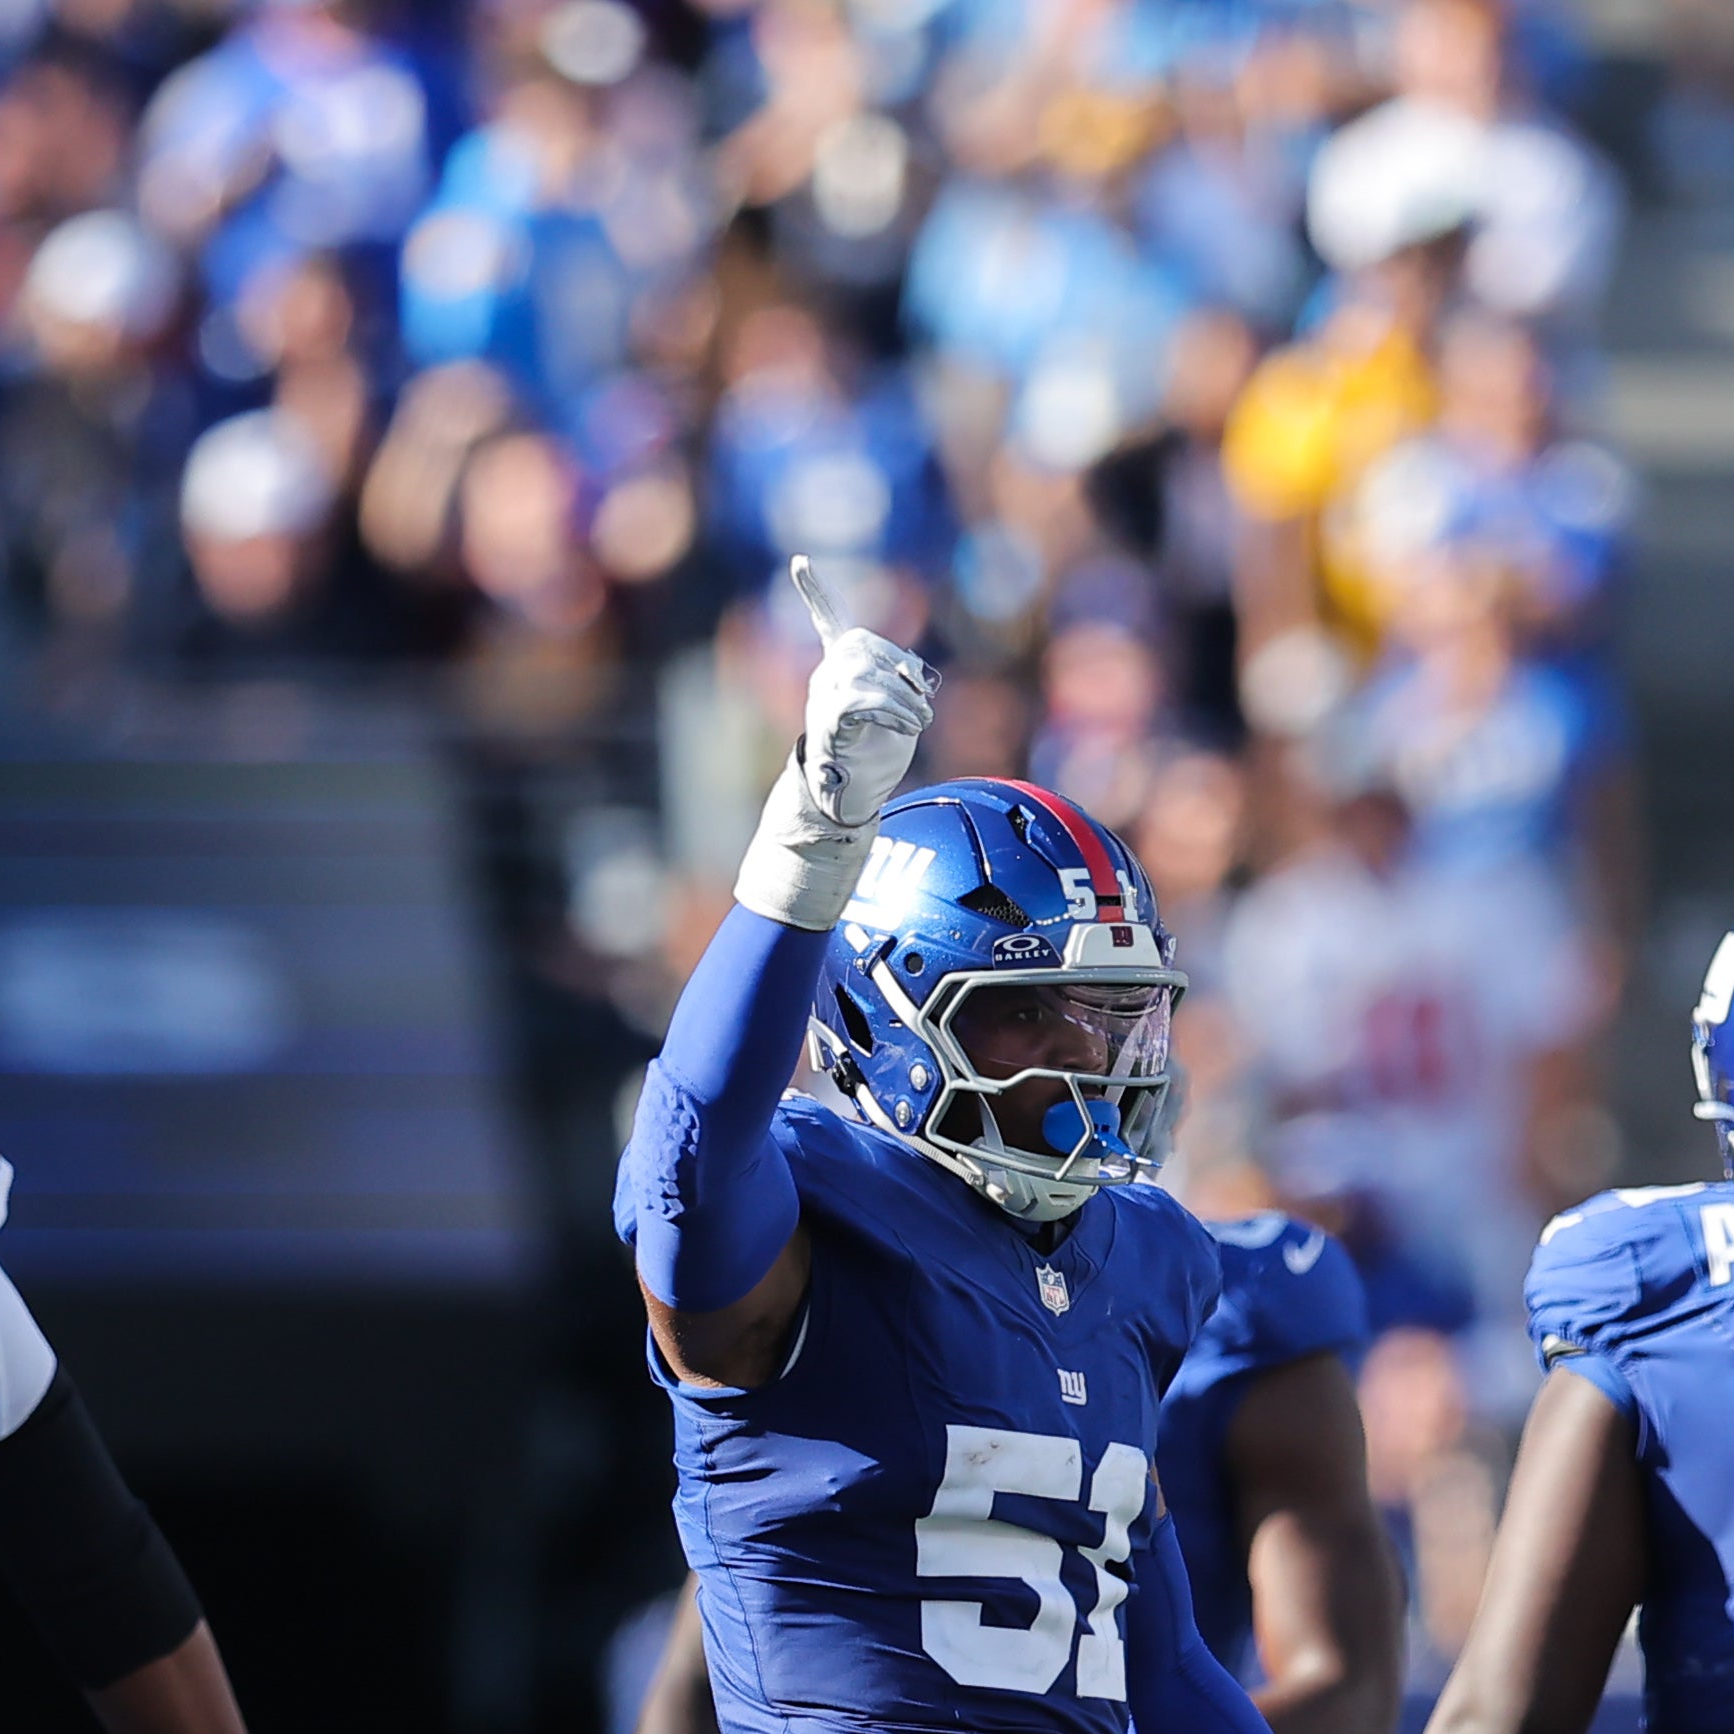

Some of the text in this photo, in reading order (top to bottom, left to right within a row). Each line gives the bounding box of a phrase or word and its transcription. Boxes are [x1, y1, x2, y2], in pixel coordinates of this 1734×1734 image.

[1057, 867, 1141, 923] 51
[994, 949, 1050, 962] OAKLEY
[914, 1424, 1151, 1702] 51
